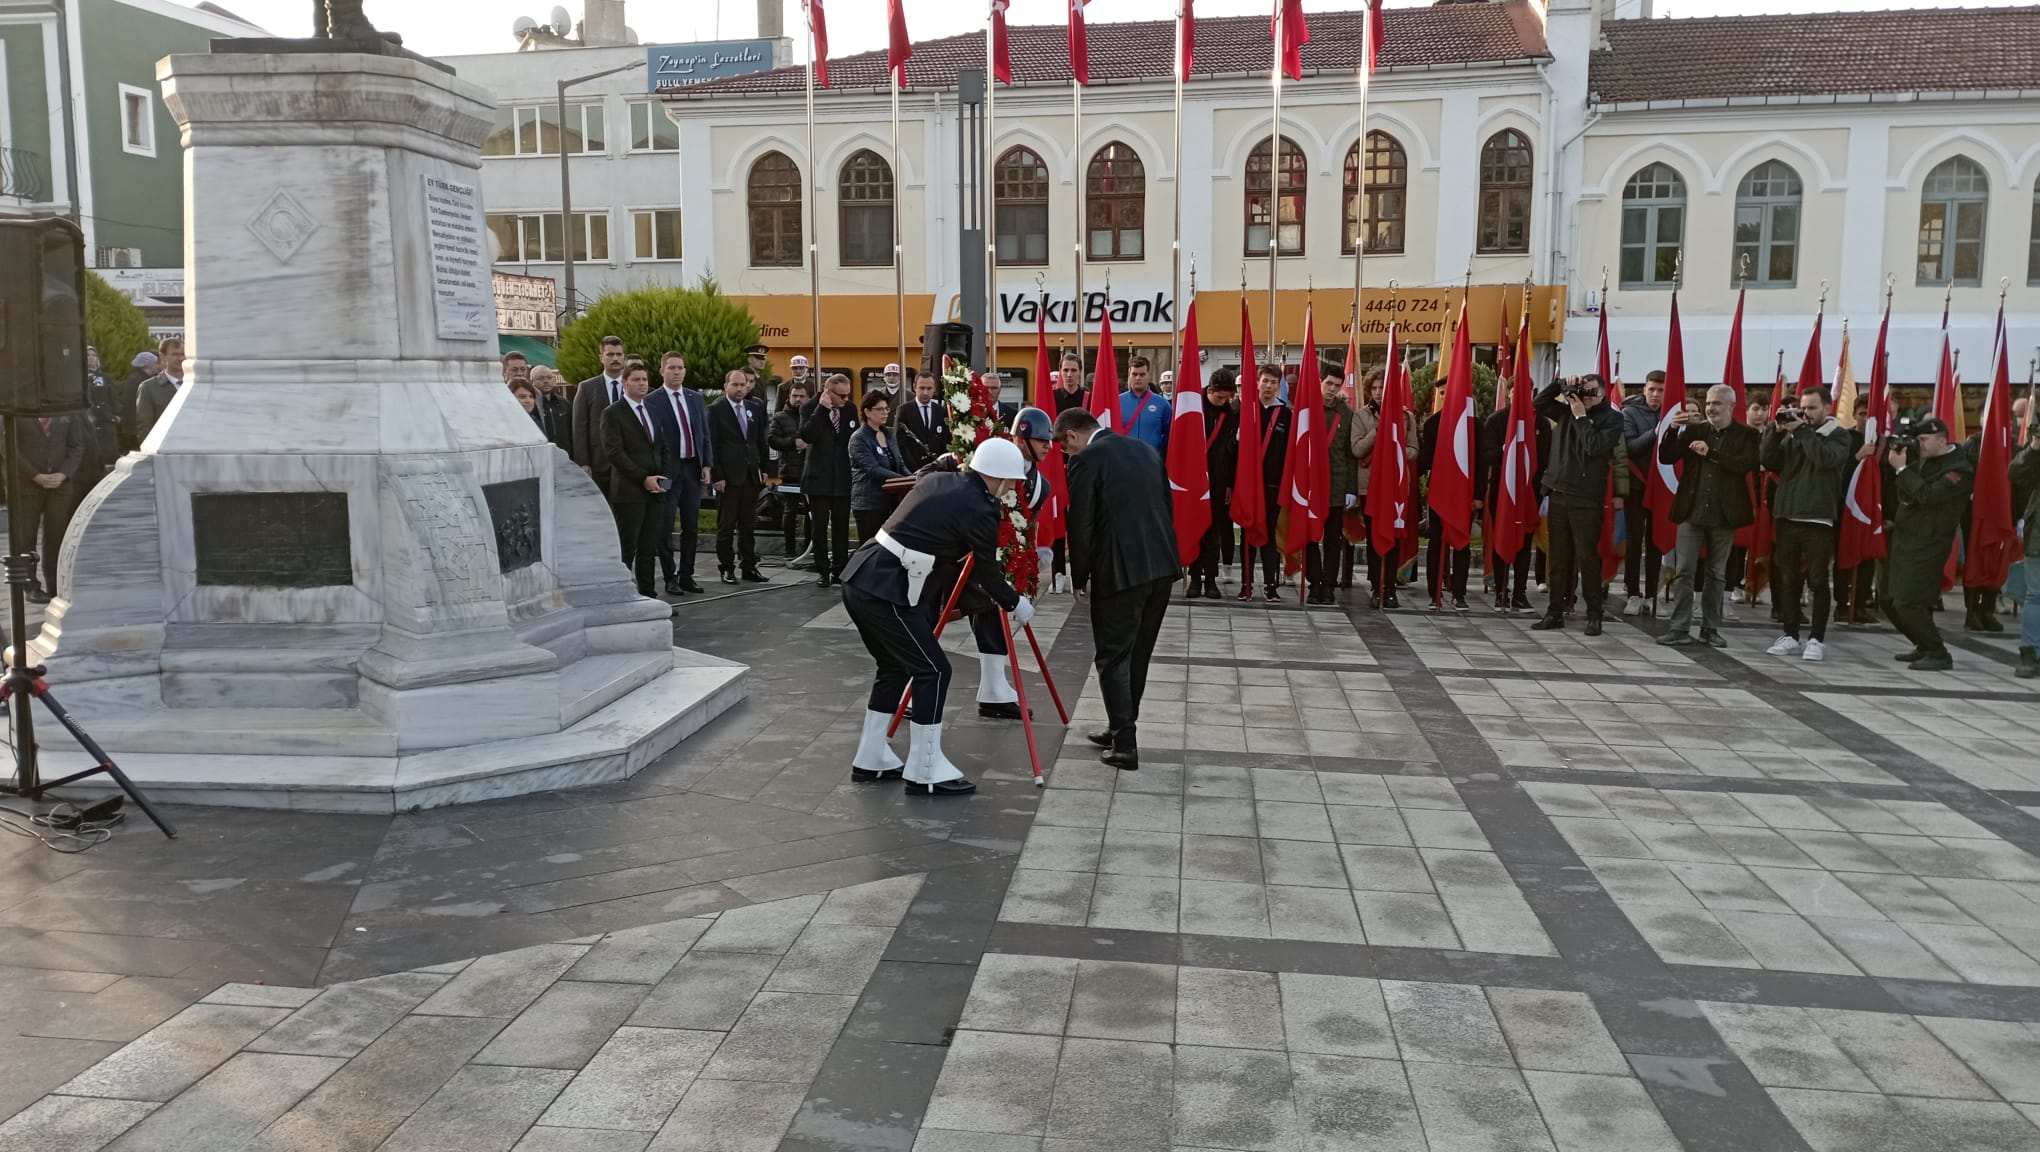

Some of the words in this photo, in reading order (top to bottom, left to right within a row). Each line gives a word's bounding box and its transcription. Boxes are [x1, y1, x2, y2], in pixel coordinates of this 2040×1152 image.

[709, 47, 762, 69] Lezzetleri
[656, 78, 680, 88] SULU
[1365, 299, 1393, 312] 444
[1397, 299, 1407, 312] 0
[1410, 298, 1438, 312] 724
[758, 323, 789, 337] dirne
